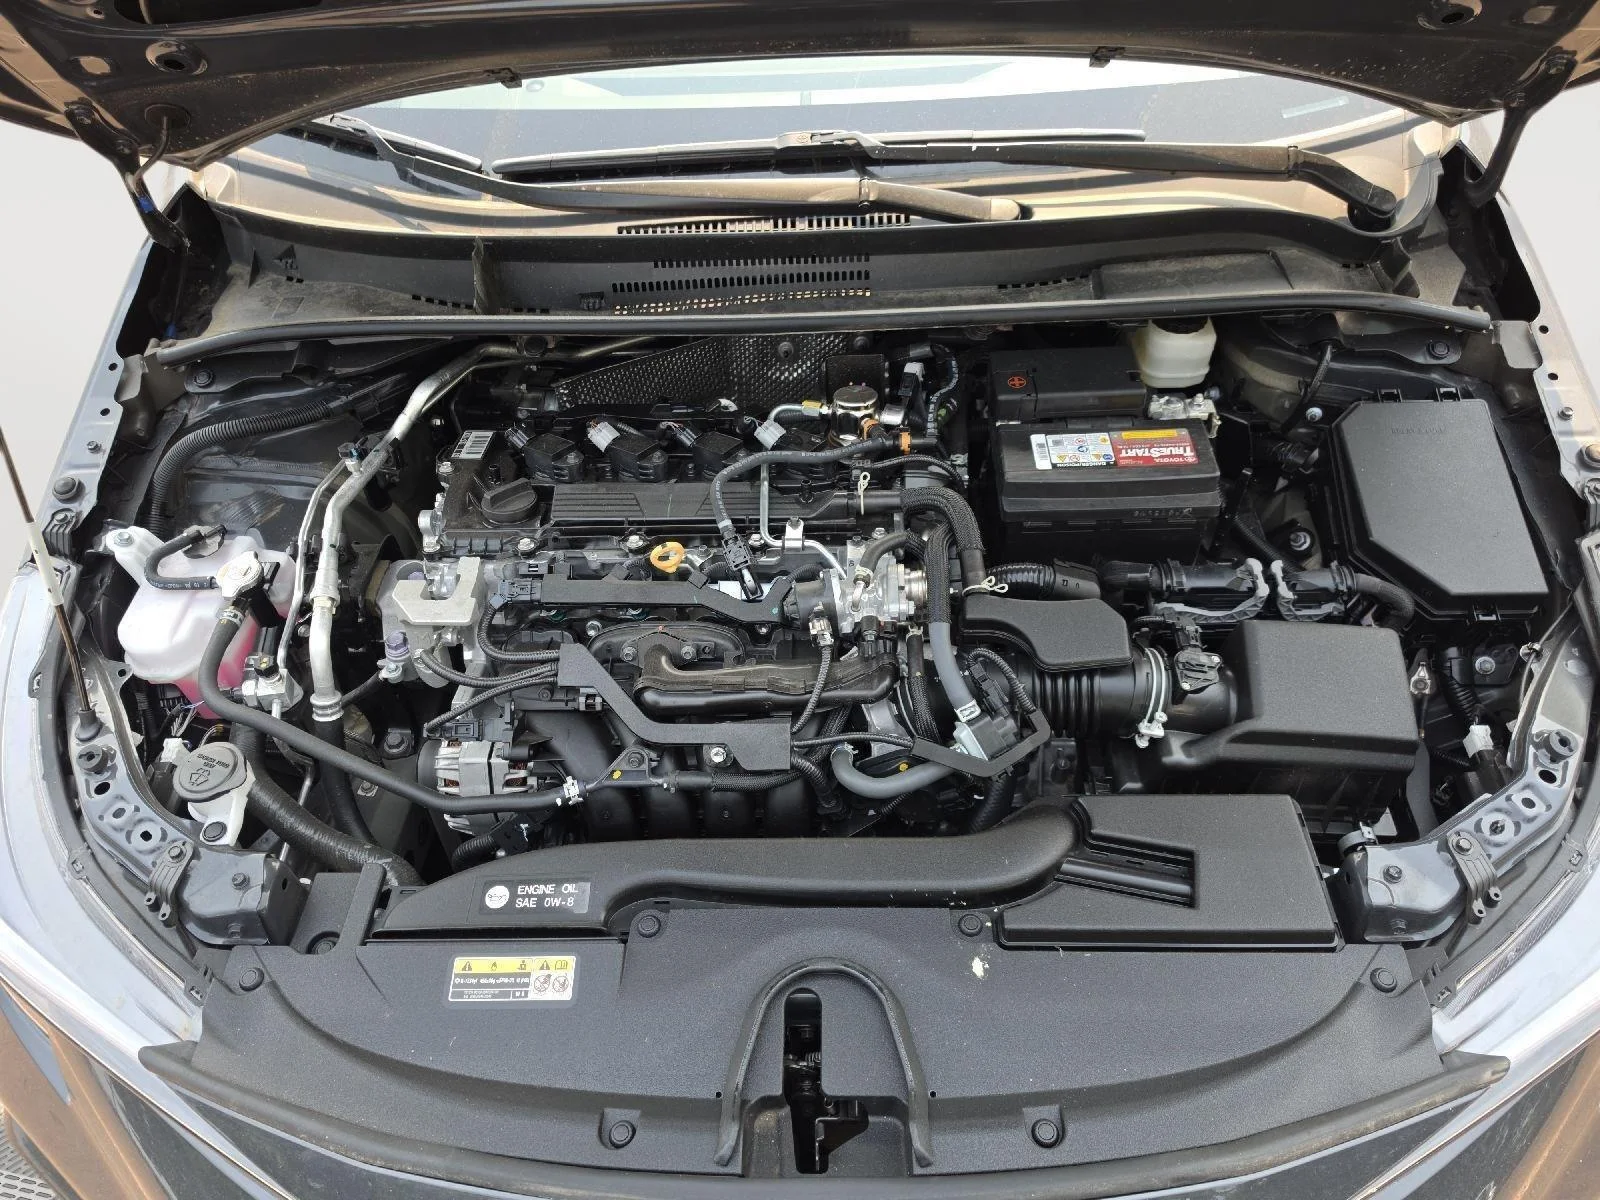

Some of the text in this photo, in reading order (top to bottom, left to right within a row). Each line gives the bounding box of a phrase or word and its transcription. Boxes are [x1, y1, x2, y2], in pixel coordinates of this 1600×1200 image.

[517, 883, 579, 895] ENGINE OIL
[515, 897, 538, 908] SAE
